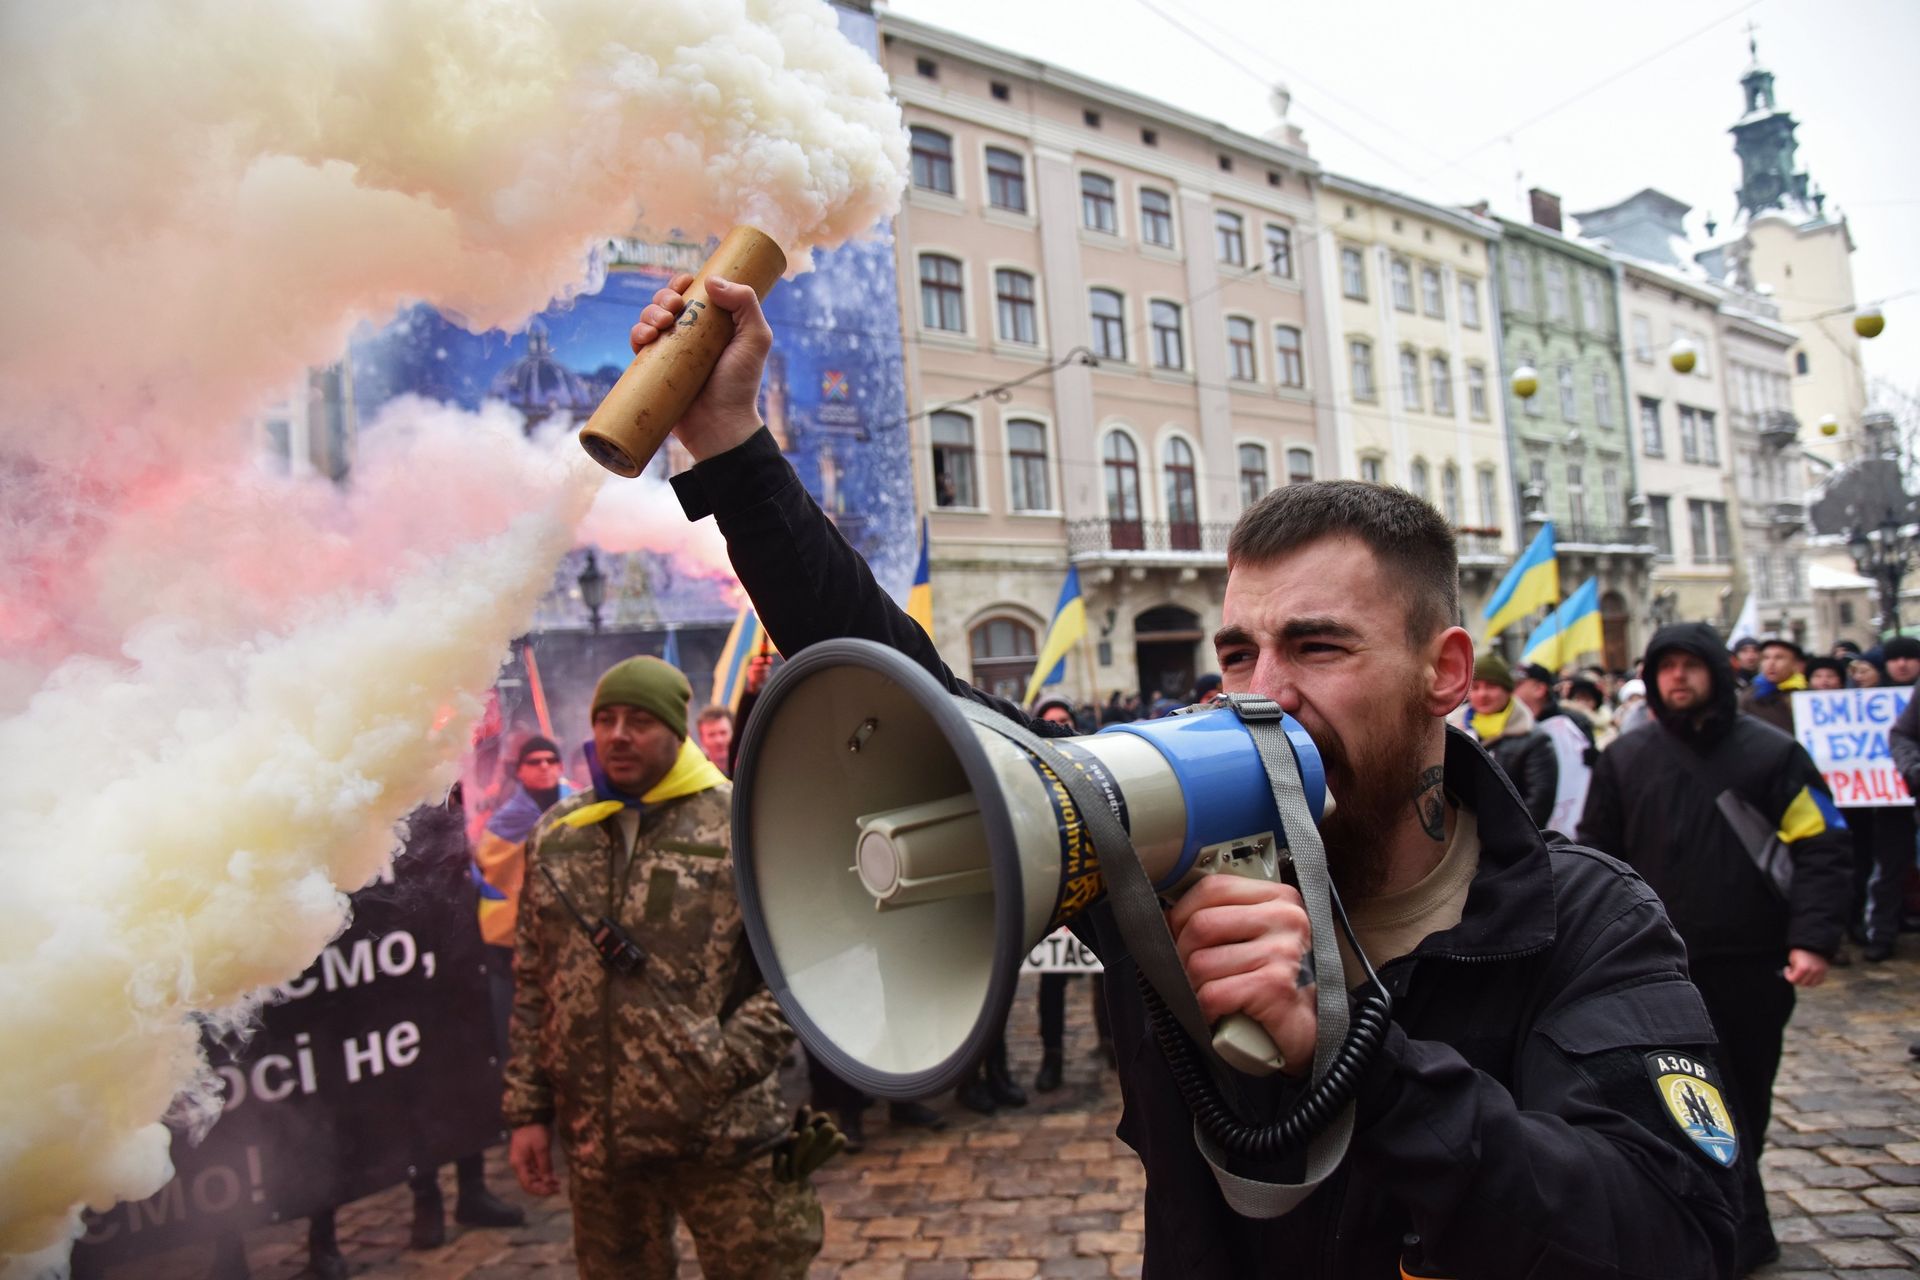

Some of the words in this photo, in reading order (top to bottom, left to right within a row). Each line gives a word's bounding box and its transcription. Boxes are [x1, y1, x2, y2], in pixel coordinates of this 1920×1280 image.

[1821, 768, 1911, 804] РАЦ
[1039, 762, 1081, 874] НАЦІОНАЛ
[343, 1020, 421, 1083] не
[1657, 1056, 1707, 1079] АЗОВ
